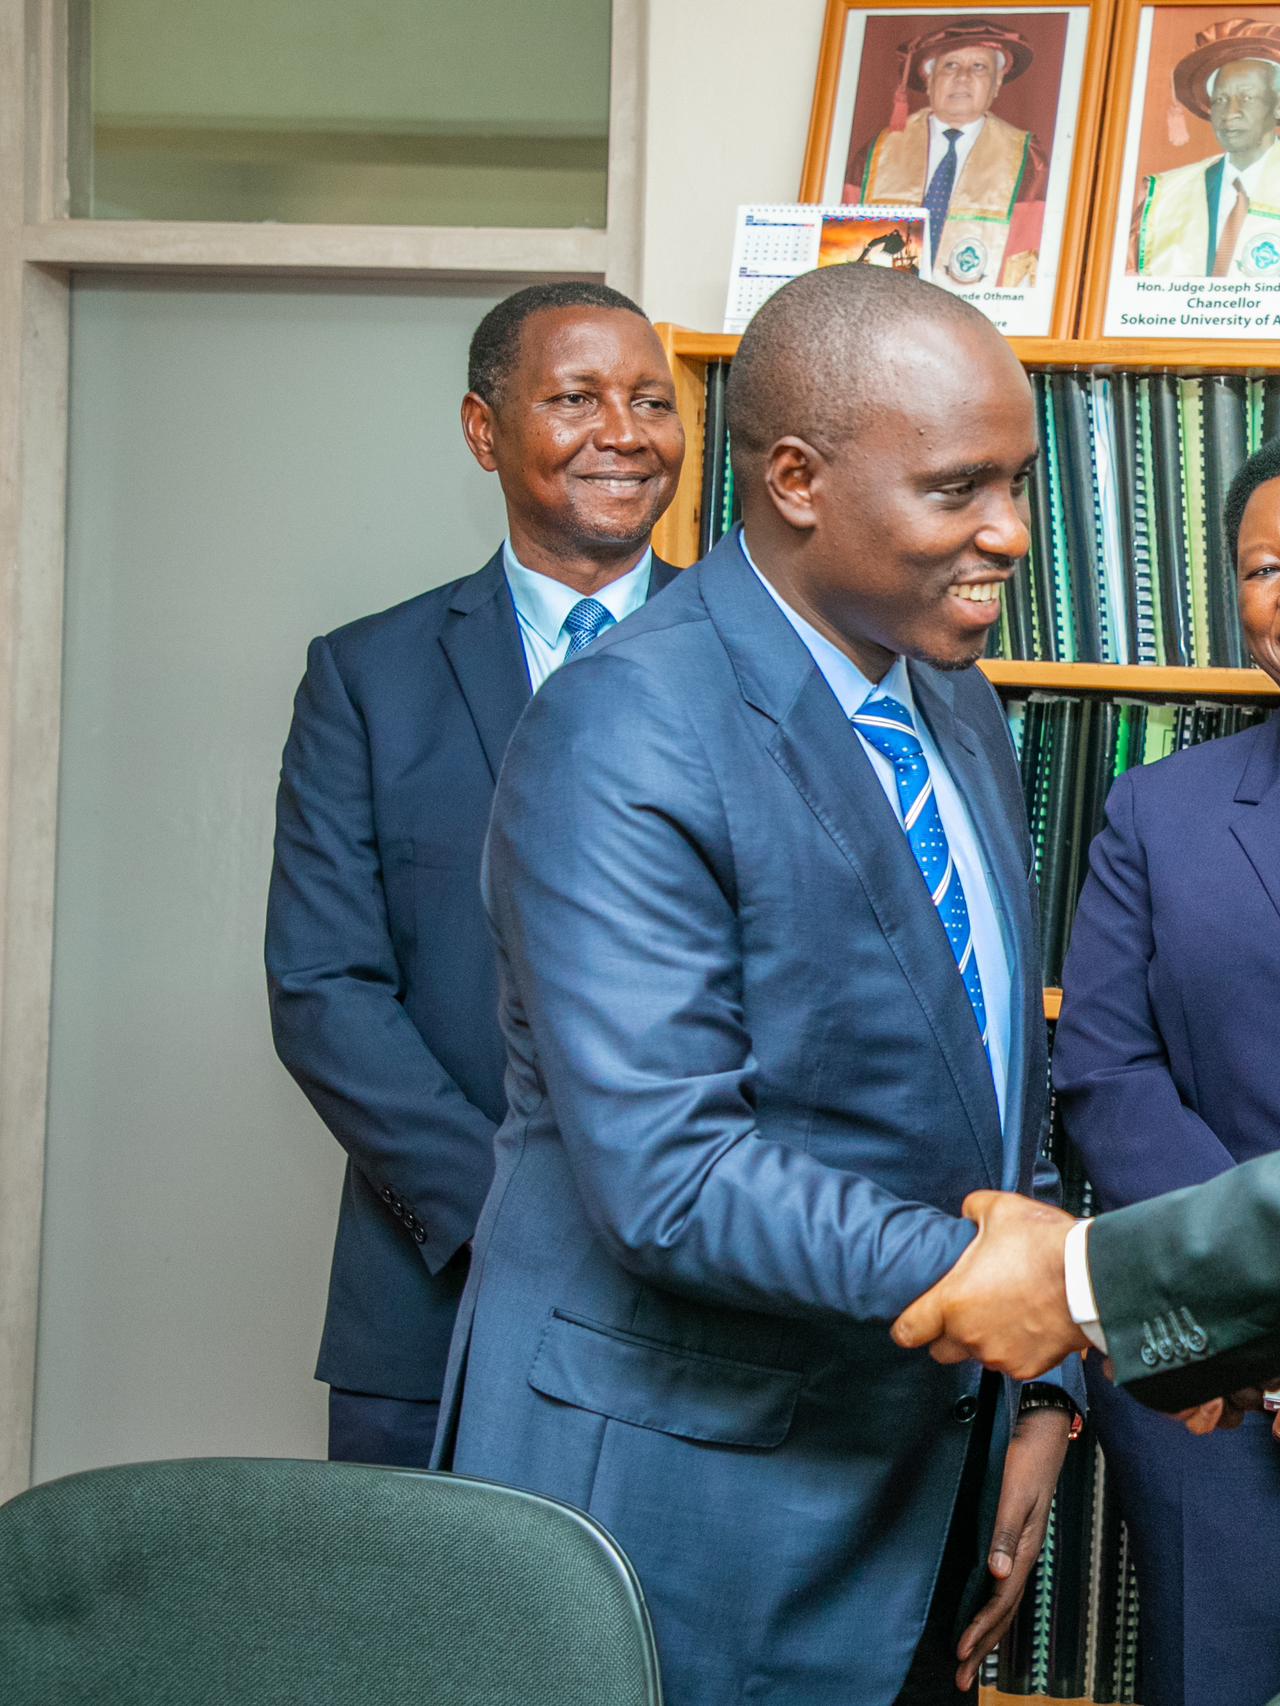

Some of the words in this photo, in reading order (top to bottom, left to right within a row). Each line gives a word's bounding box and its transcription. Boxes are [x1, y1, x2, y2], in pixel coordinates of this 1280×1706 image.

[1136, 281, 1165, 293] Hon.
[1168, 281, 1205, 294] Judge
[1207, 282, 1251, 295] Joseph
[983, 291, 1024, 301] Othman
[1187, 297, 1261, 309] Chancellor
[1120, 313, 1177, 326] Sokoine
[1180, 313, 1252, 328] University
[1254, 314, 1270, 326] of
